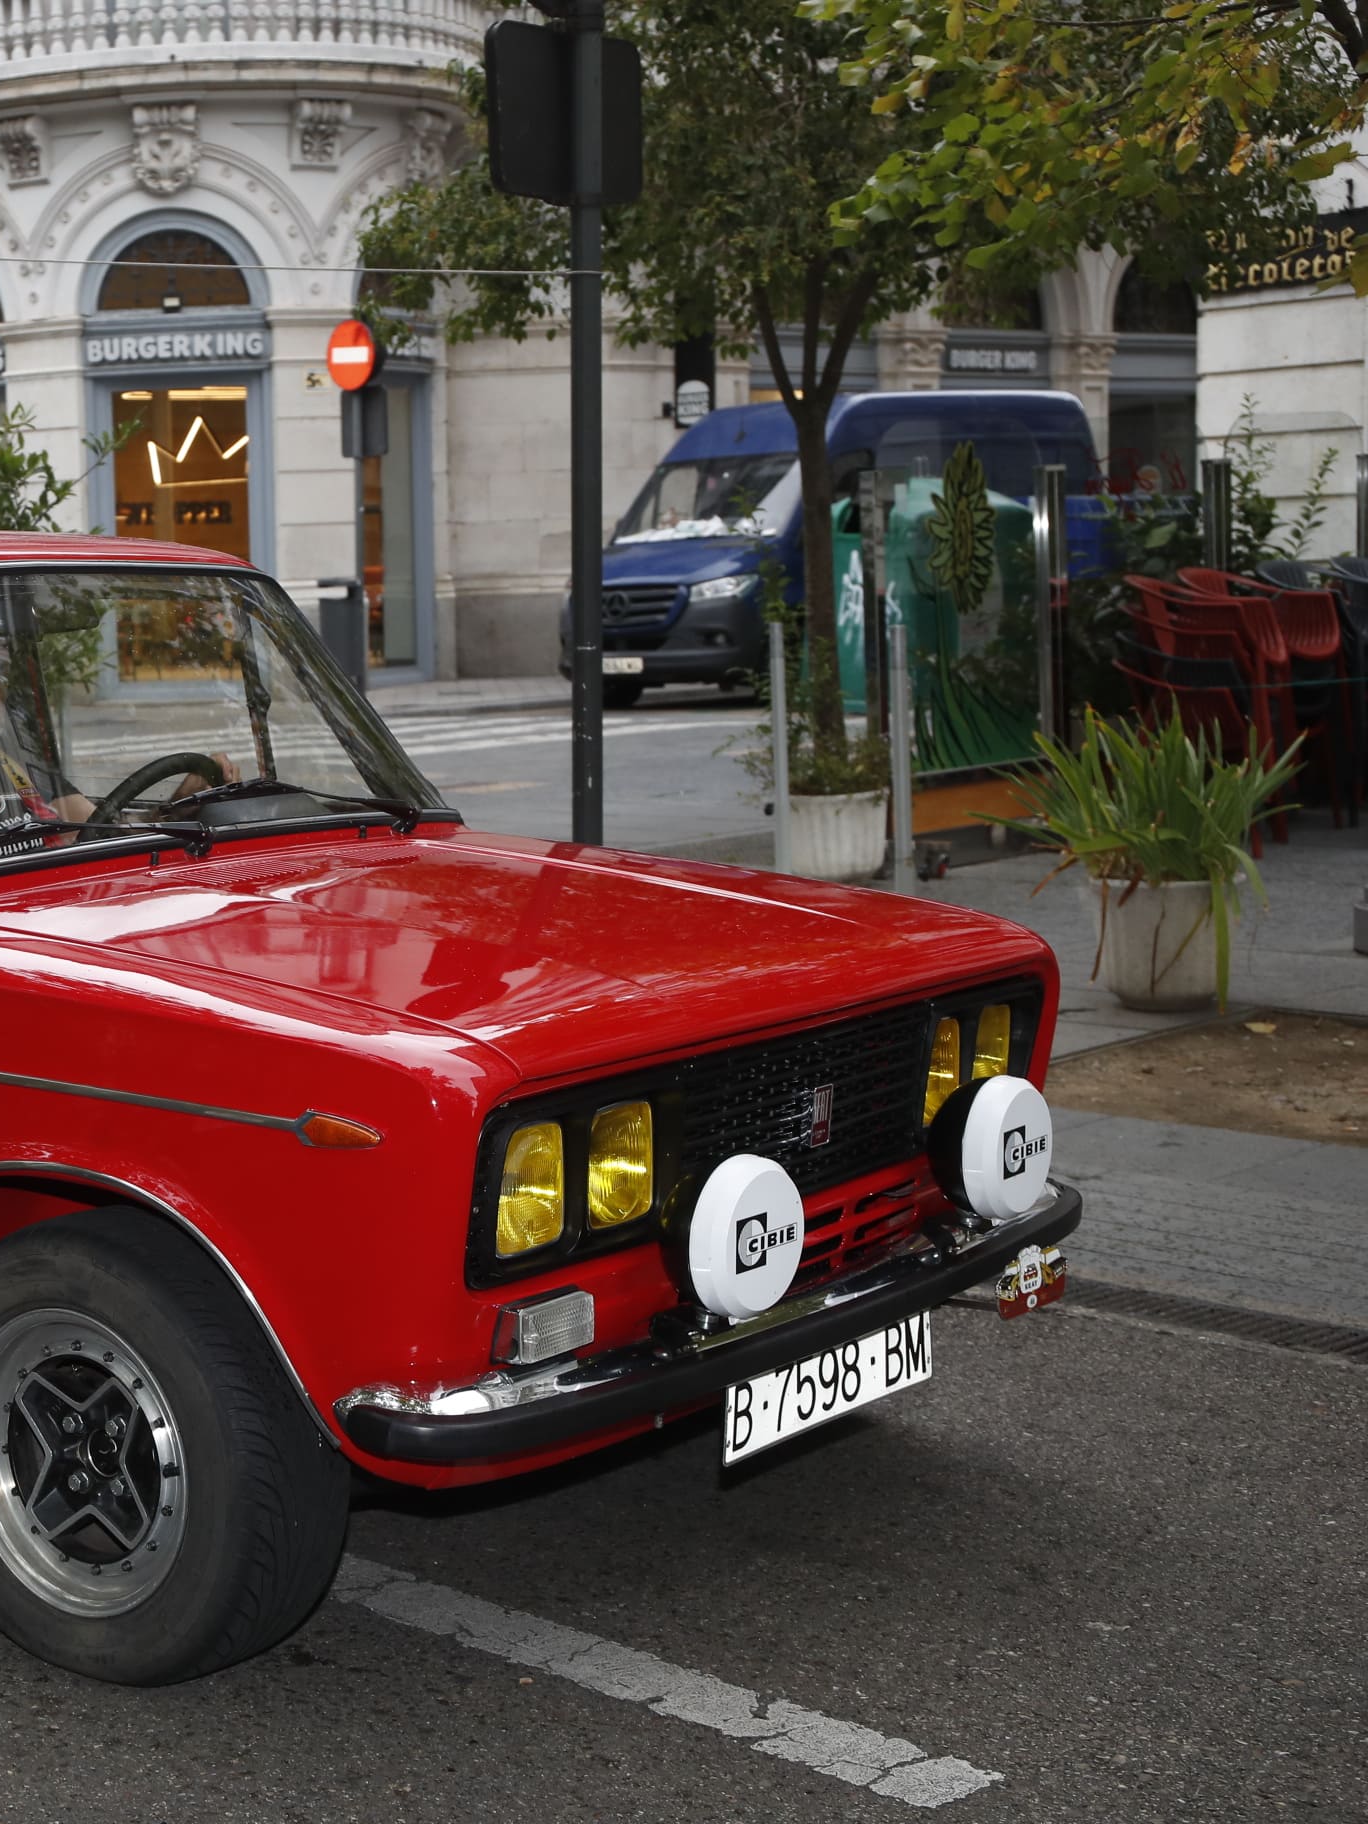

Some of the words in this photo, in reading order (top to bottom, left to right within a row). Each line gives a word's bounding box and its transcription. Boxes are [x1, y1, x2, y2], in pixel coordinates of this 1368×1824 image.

[87, 335, 190, 363] BURGER
[193, 331, 265, 358] KING
[813, 1089, 831, 1125] SEAT
